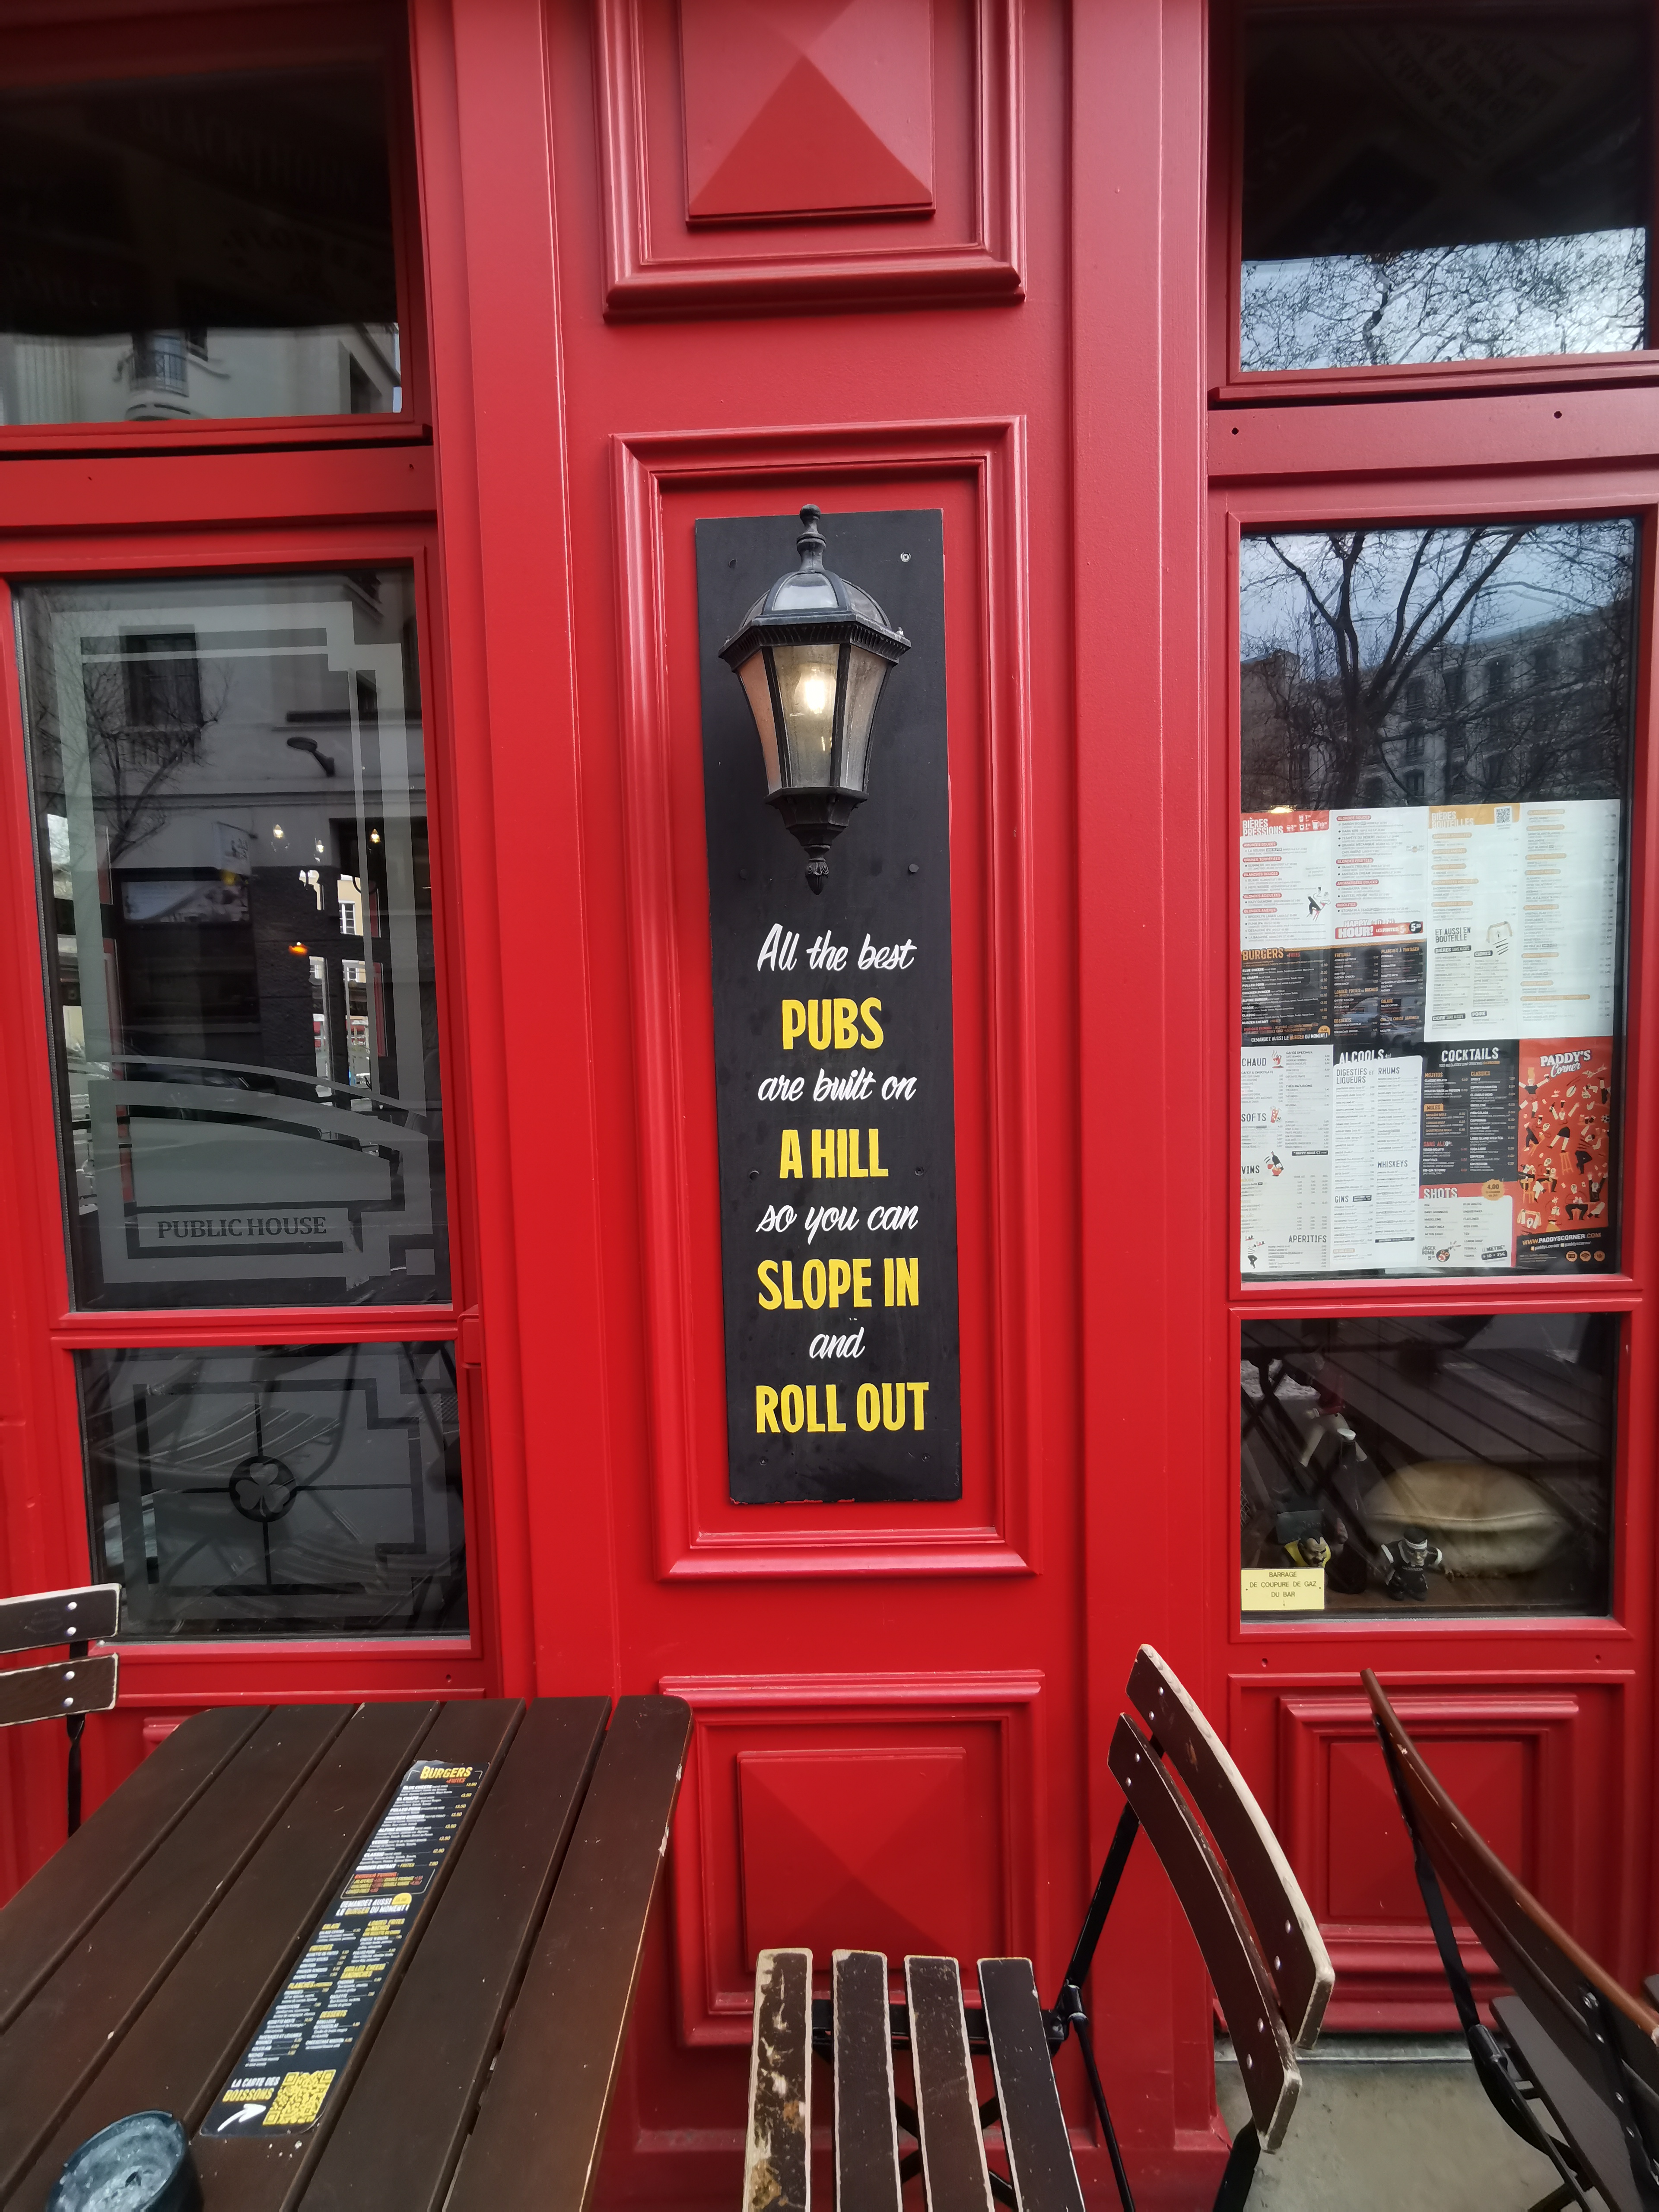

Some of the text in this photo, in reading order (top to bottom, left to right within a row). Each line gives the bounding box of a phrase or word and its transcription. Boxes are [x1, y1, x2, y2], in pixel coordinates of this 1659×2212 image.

[1432, 810, 1456, 821] BIÈRES
[1243, 817, 1268, 829] BIÈRES
[1432, 818, 1474, 828] BOUTEILLES
[1243, 826, 1283, 836] PRESSIONS
[1344, 919, 1369, 927] HAPPY
[1338, 926, 1373, 938] HOUR!
[1435, 934, 1467, 943] BOUTEILLE
[757, 923, 917, 972] All the best
[1243, 948, 1284, 960] BURGERS
[782, 997, 884, 1050] PUBS
[1340, 1049, 1384, 1064] ALCOOLS
[1441, 1047, 1499, 1062] COCKTAILS
[1540, 1050, 1591, 1067] PADDY'S
[1242, 1058, 1267, 1066] CHAUD
[1337, 1068, 1367, 1076] DIGESTIFS
[1551, 1062, 1581, 1077] Corner
[758, 1067, 917, 1102] are built on
[1241, 1113, 1267, 1122] SOFTS
[780, 1128, 889, 1179] A HILL
[1241, 1165, 1260, 1174] VINS
[1377, 1160, 1408, 1168] WHISKEYS
[1424, 1187, 1458, 1199] SHOTS
[158, 1217, 327, 1238] PUBLIC HOUSE
[756, 1205, 919, 1245] so you can
[1522, 1233, 1602, 1245] WWW.PADDYSCORNER.COM
[757, 1257, 919, 1310] SLOPE IN
[809, 1326, 865, 1359] and
[756, 1382, 929, 1433] ROLL OUT
[420, 1766, 473, 1780] BURGERS
[340, 1899, 372, 1908] DEMANDEZ
[345, 1907, 370, 1915] BURGER
[231, 2076, 280, 2088] LA CARTE DES
[222, 2088, 274, 2102] BOISSONS
